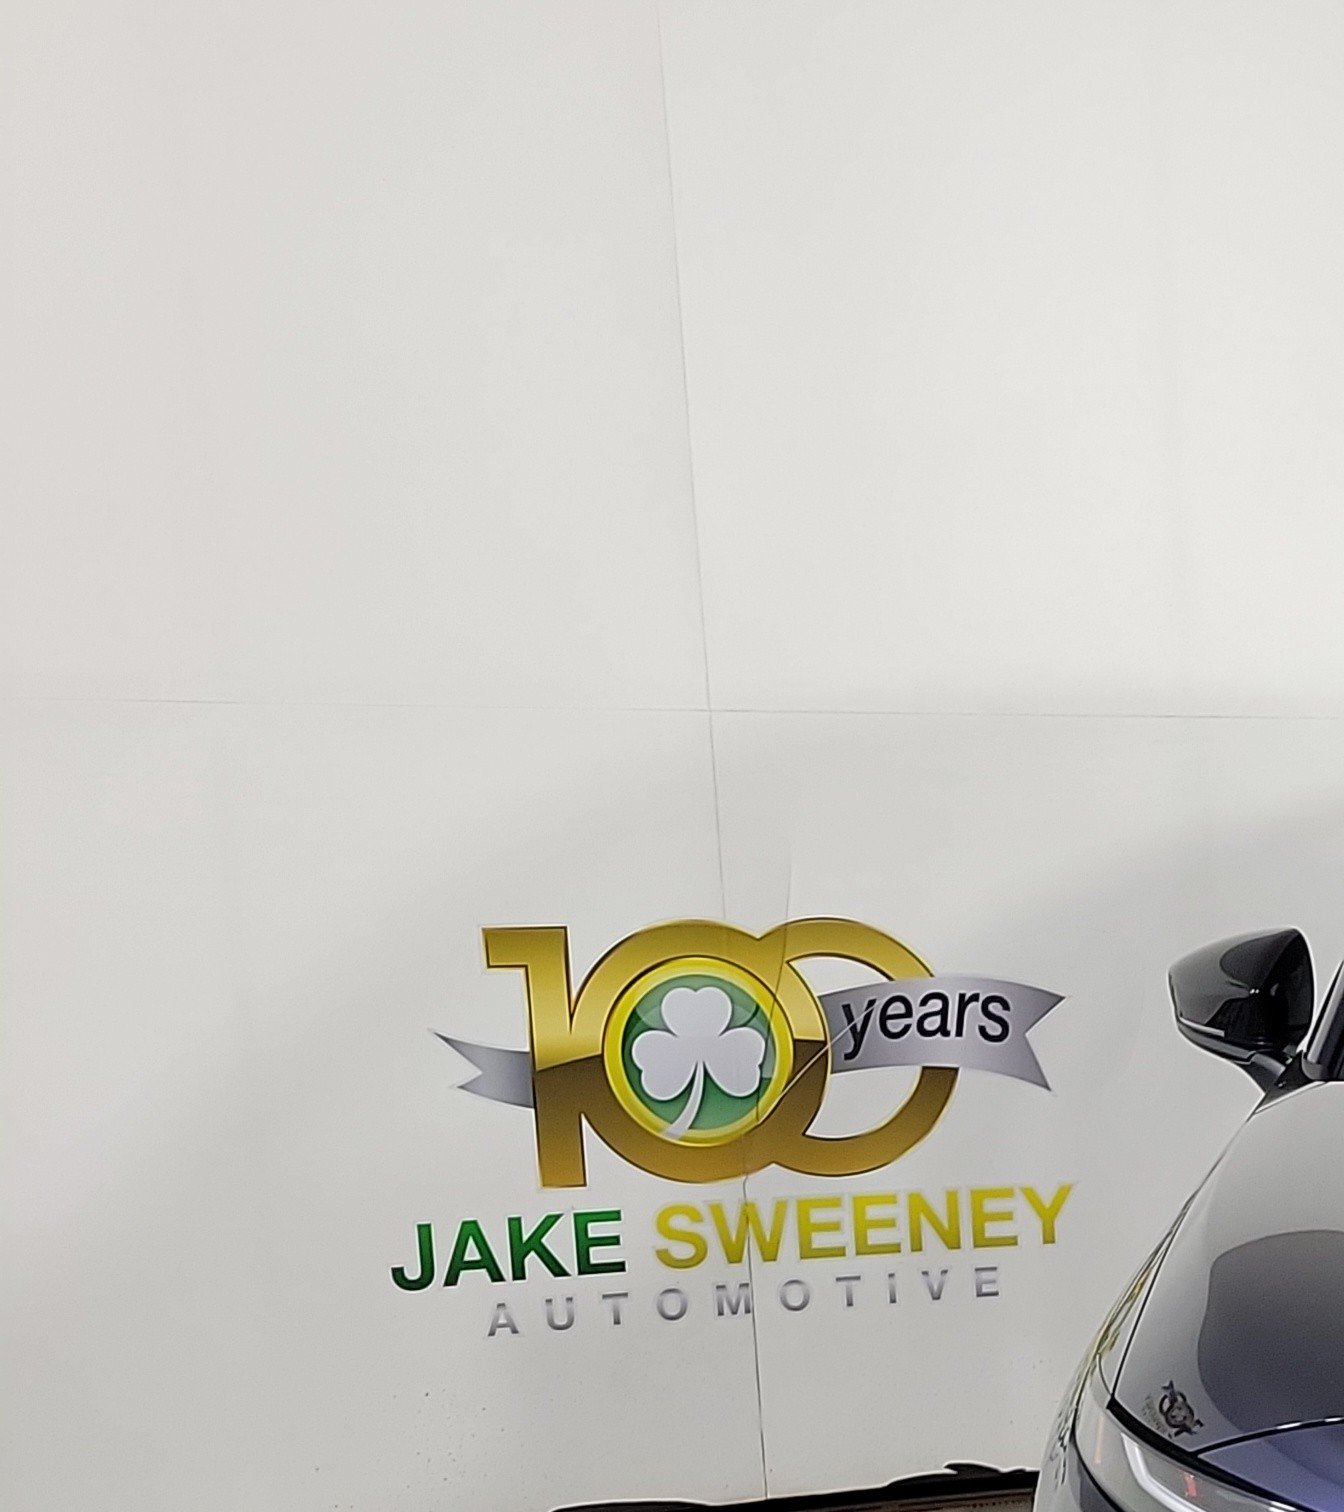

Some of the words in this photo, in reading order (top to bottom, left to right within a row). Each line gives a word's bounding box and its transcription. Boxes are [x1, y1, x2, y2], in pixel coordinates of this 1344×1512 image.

[481, 917, 959, 1188] 100
[842, 989, 1011, 1061] years
[390, 1209, 627, 1292] JAKE
[654, 1184, 1074, 1269] SWEENEY
[486, 1265, 1001, 1338] AUTOMOTIVE
